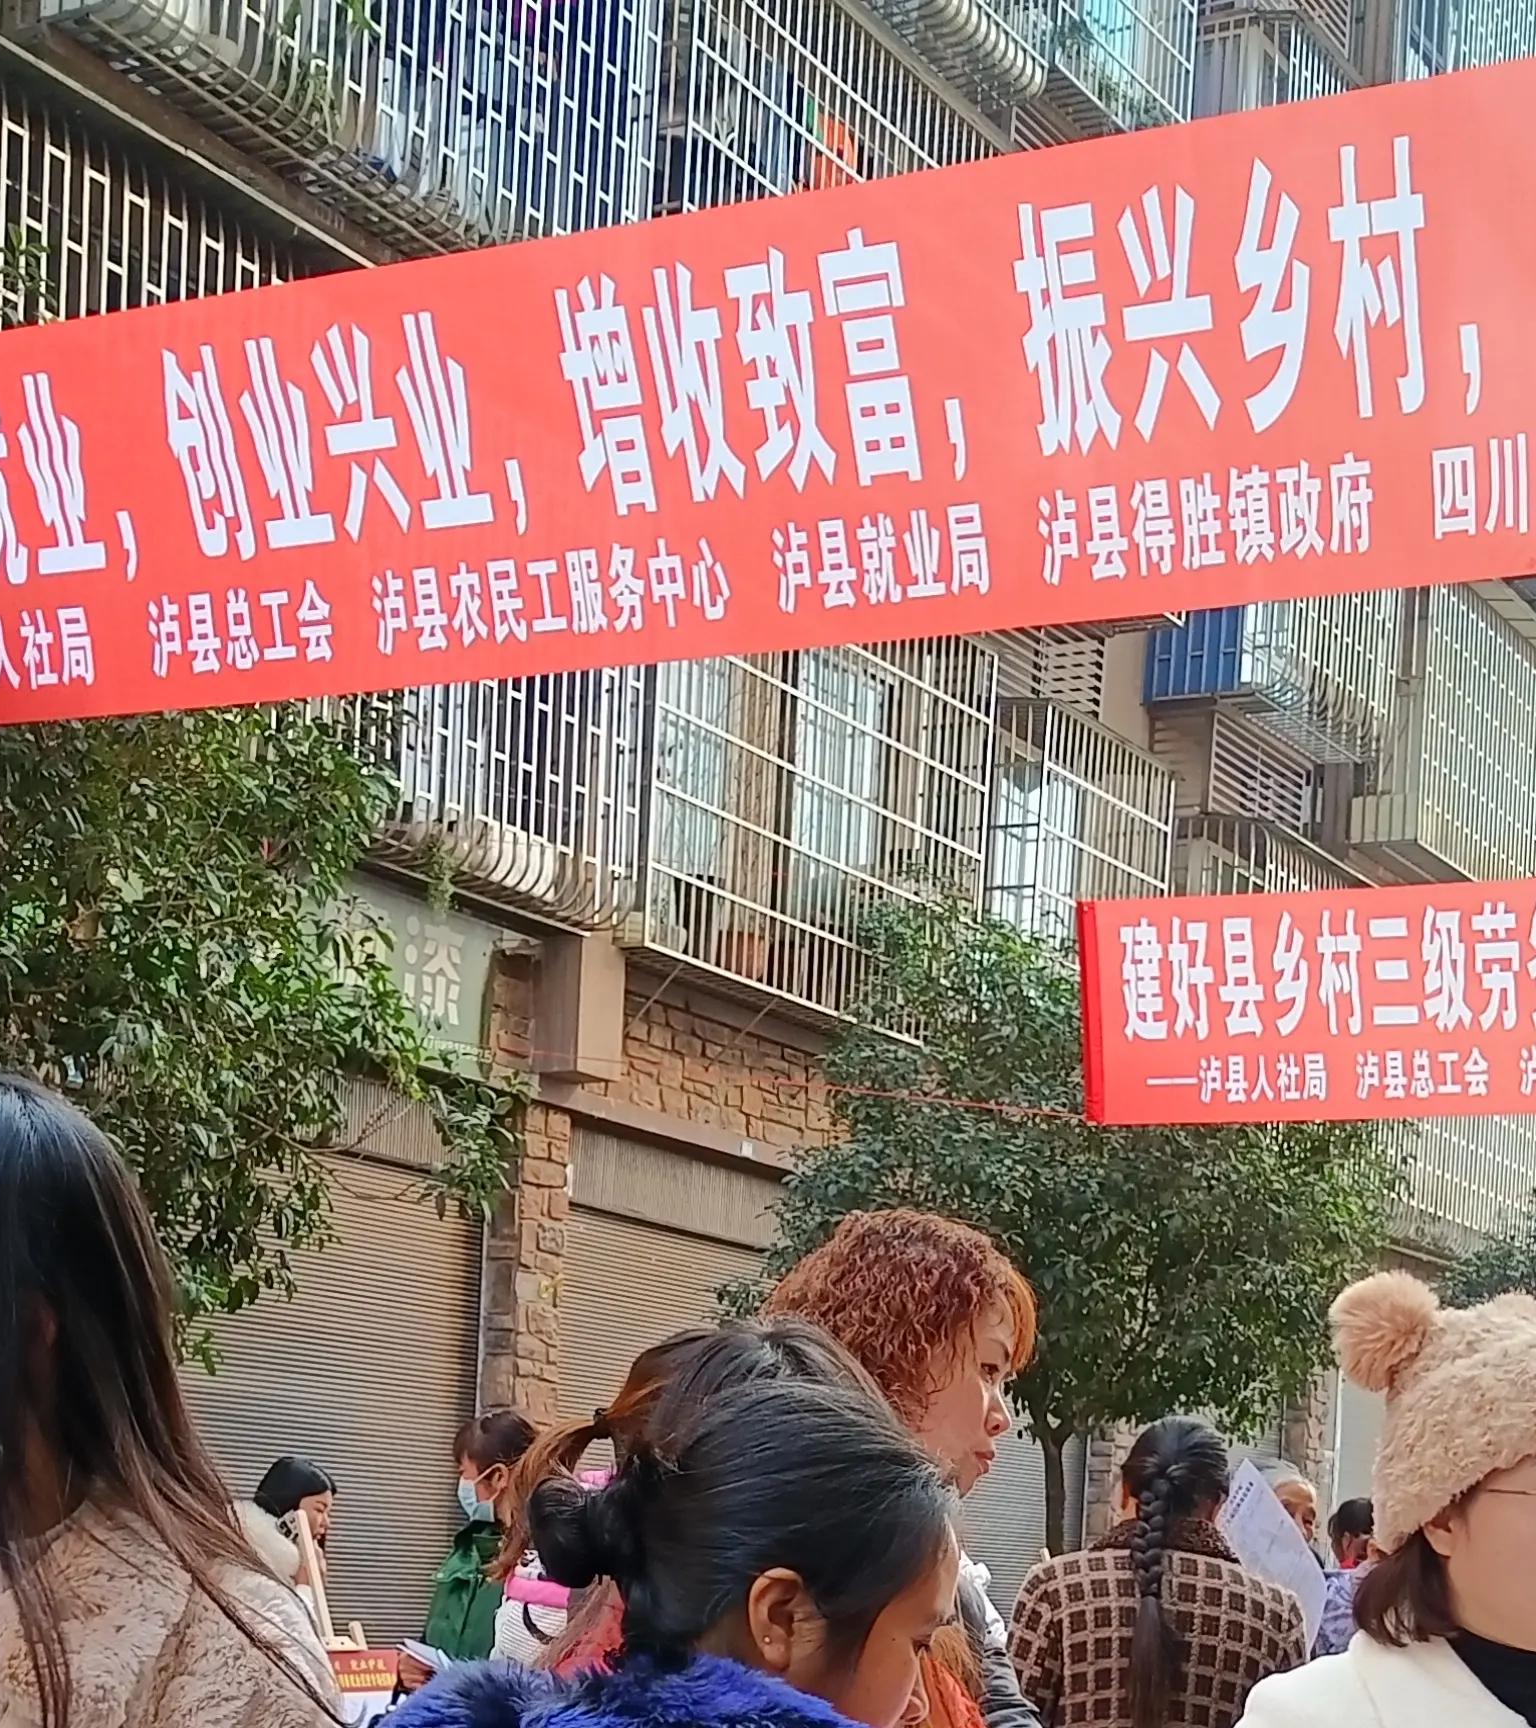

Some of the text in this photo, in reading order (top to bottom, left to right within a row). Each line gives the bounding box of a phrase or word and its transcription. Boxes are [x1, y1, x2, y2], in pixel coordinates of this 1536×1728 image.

[148, 579, 333, 680] 泸县总工会
[371, 535, 732, 656] 泸县农民工服务中心
[772, 501, 992, 615] 泸县就业局
[1037, 450, 1375, 586] 泸县得胜镇政府
[1355, 1046, 1491, 1102] 泸县总工会
